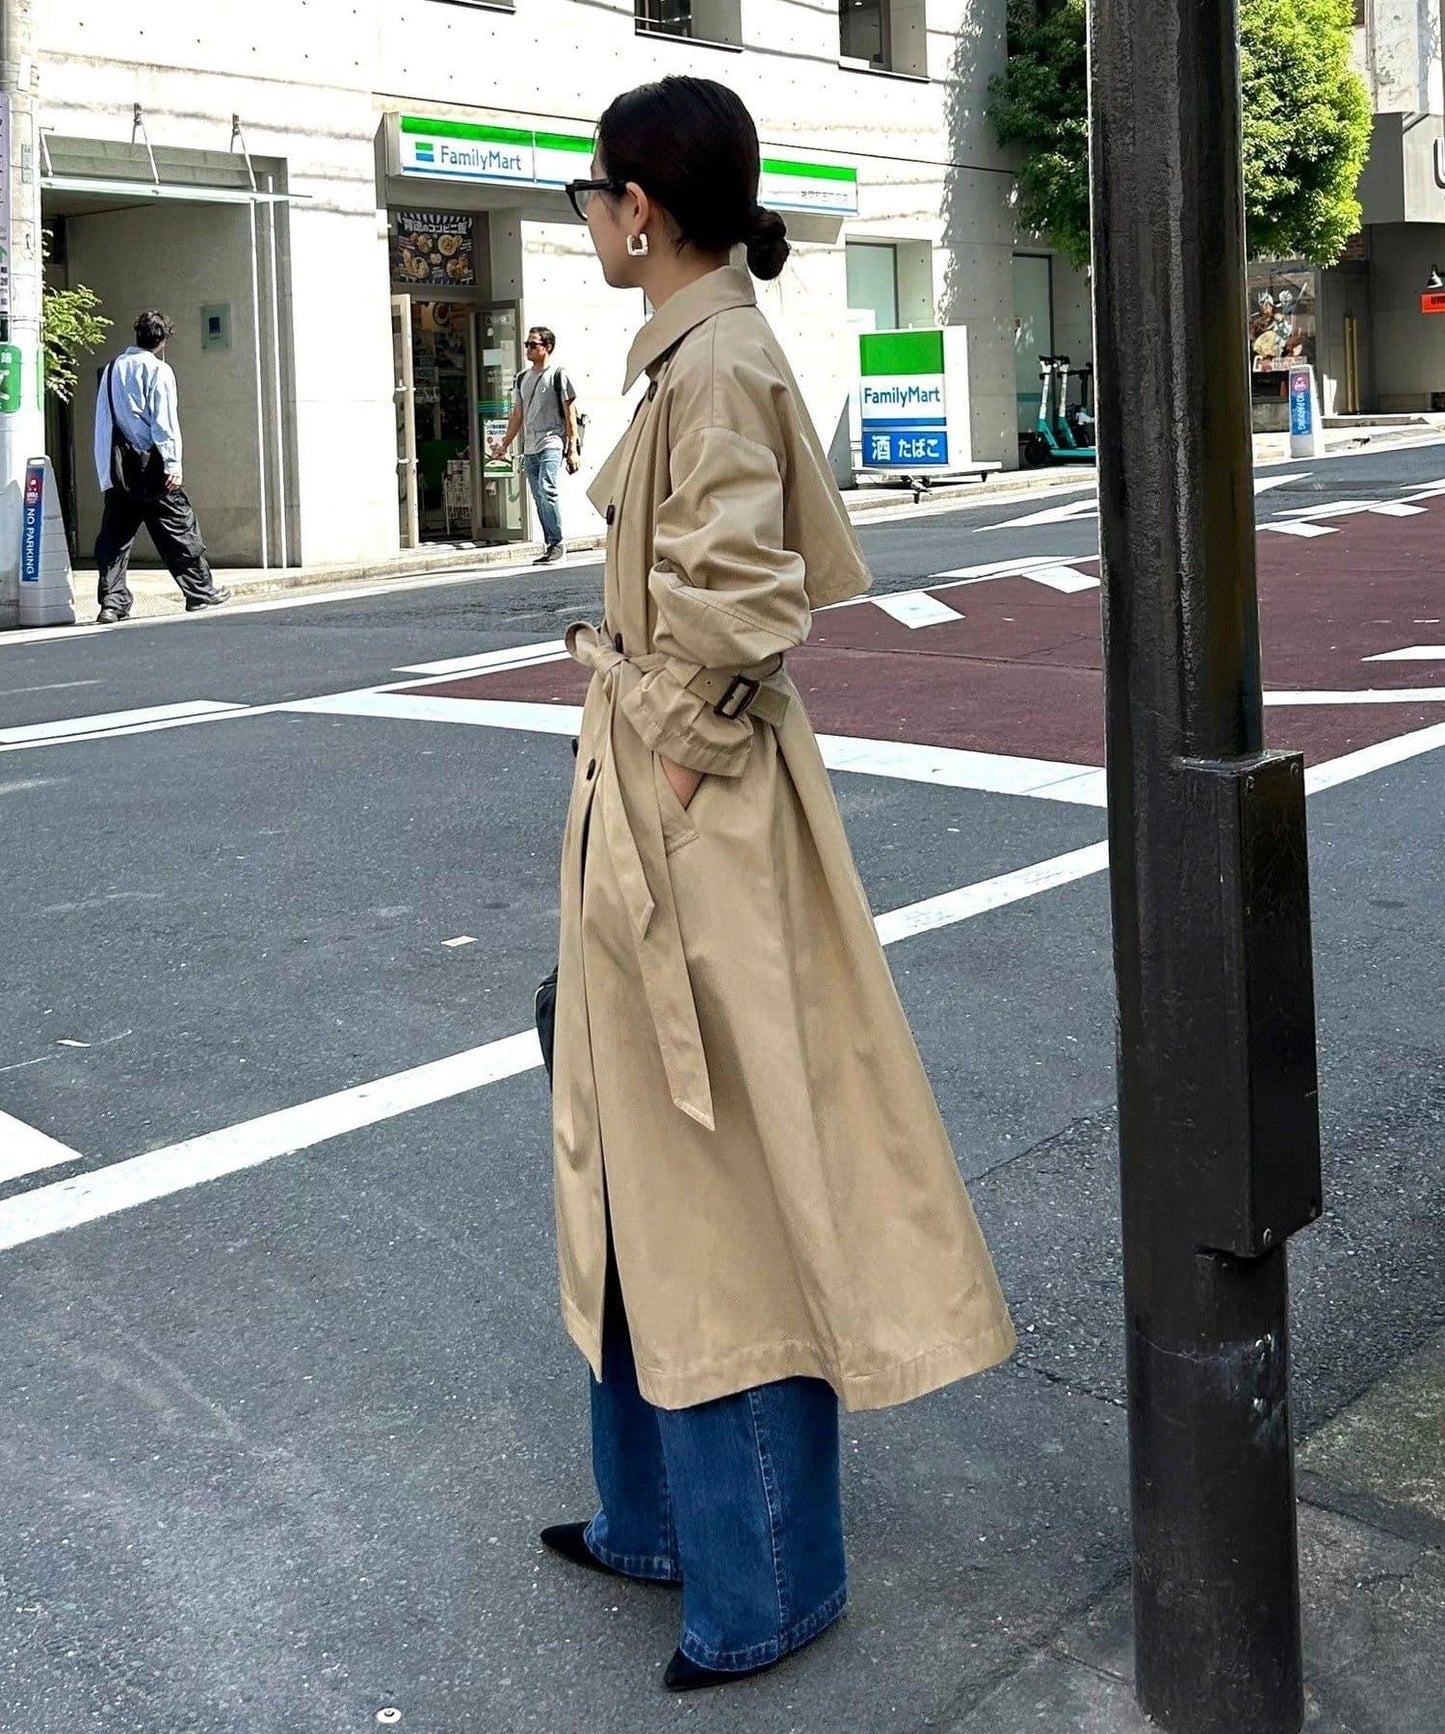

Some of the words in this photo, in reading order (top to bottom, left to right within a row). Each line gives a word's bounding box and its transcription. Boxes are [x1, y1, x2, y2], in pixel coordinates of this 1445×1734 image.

[441, 145, 522, 171] FamilyMart
[864, 386, 940, 408] FamilyMart
[871, 435, 891, 460] 酒
[898, 438, 940, 458] たばこ
[27, 508, 35, 525] NO
[26, 527, 35, 574] PARKING
